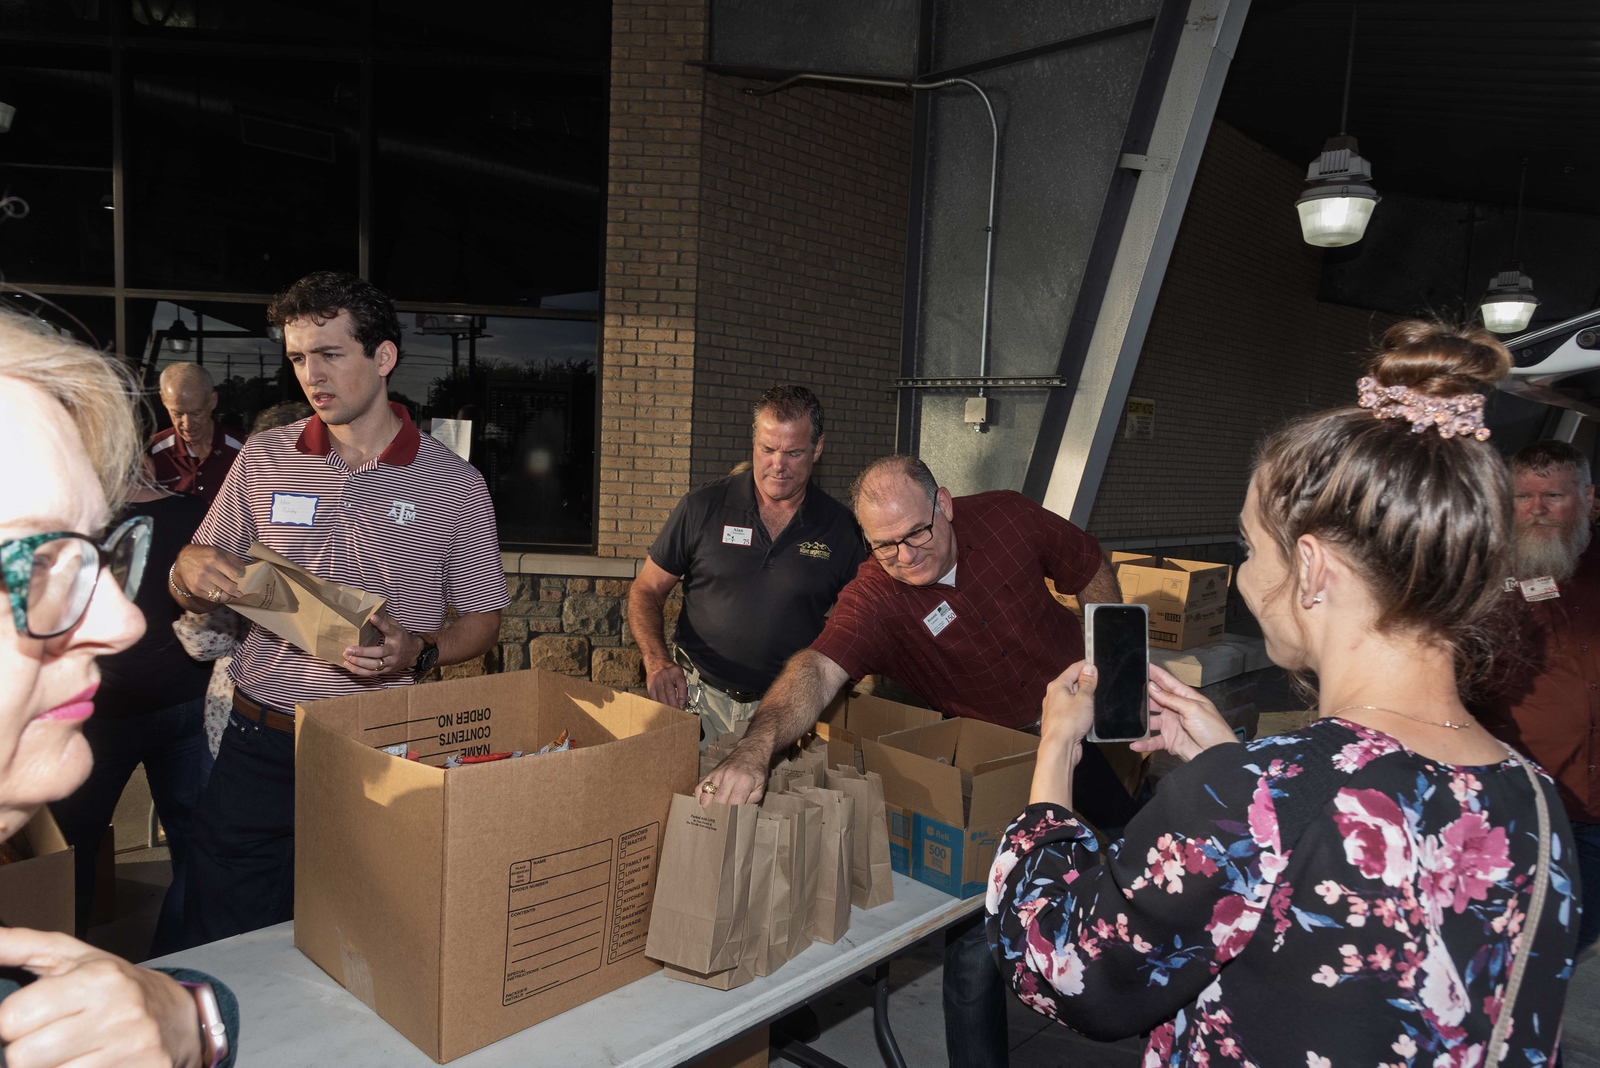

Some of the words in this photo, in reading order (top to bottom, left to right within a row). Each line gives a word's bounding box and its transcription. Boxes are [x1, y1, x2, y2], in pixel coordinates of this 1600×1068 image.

[945, 613, 955, 623] 150
[456, 708, 491, 724] ORDER
[439, 725, 491, 746] CONTENTS
[460, 744, 491, 757] NAME
[621, 828, 648, 841] BEDROOMS
[627, 836, 647, 846] MASTER
[929, 844, 946, 859] 500
[626, 858, 642, 868] FAMILY
[626, 868, 641, 876] LIVING
[512, 885, 528, 893] ORDER
[529, 881, 548, 889] NUMBER
[624, 885, 640, 894] DINING
[623, 892, 644, 903] KITCHEN
[511, 908, 536, 918] CONTENTS
[623, 904, 635, 912] BATH
[622, 907, 648, 921] BASEMENT
[621, 918, 641, 929] GARAGE
[620, 929, 633, 938] ATTIC
[619, 934, 641, 947] LAUNDRY
[507, 969, 526, 977] SPECIAL
[507, 968, 539, 982] INSTRUCTIONS
[506, 987, 528, 998] PACKER'S
[506, 993, 524, 1002] INITIALS
